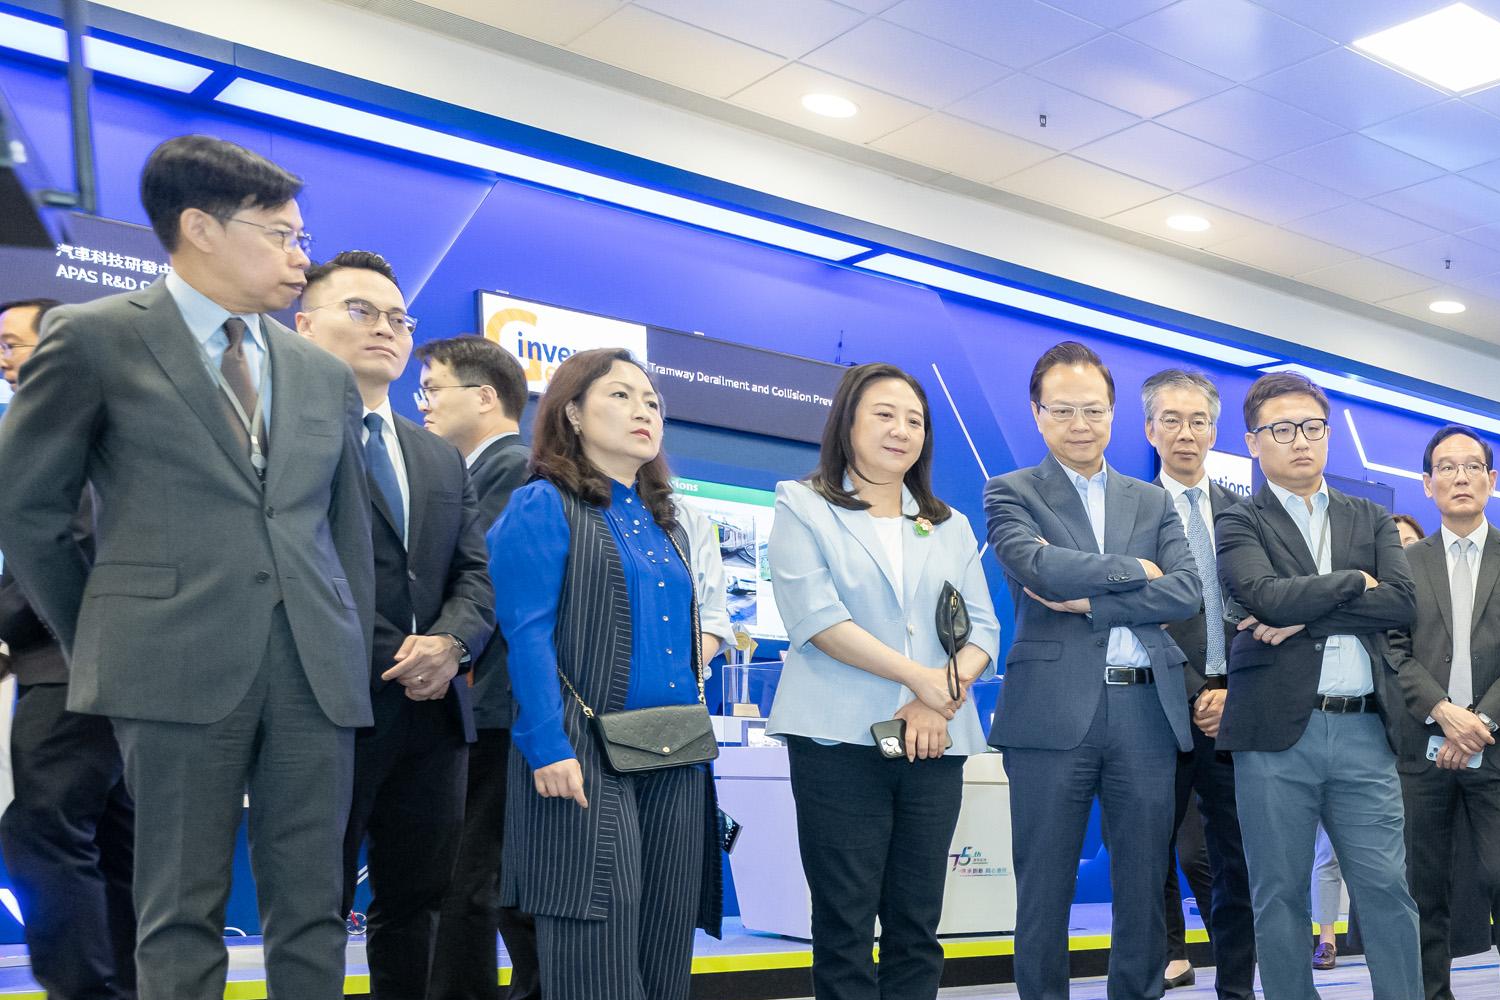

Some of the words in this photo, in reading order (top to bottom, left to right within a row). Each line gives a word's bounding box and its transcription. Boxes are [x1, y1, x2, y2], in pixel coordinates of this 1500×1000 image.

[56, 264, 98, 284] APAS
[102, 272, 137, 290] R&D
[518, 332, 577, 363] inve
[649, 362, 695, 382] Tramway
[697, 372, 749, 391] Derailment
[752, 383, 769, 394] and
[772, 386, 812, 402] Collision
